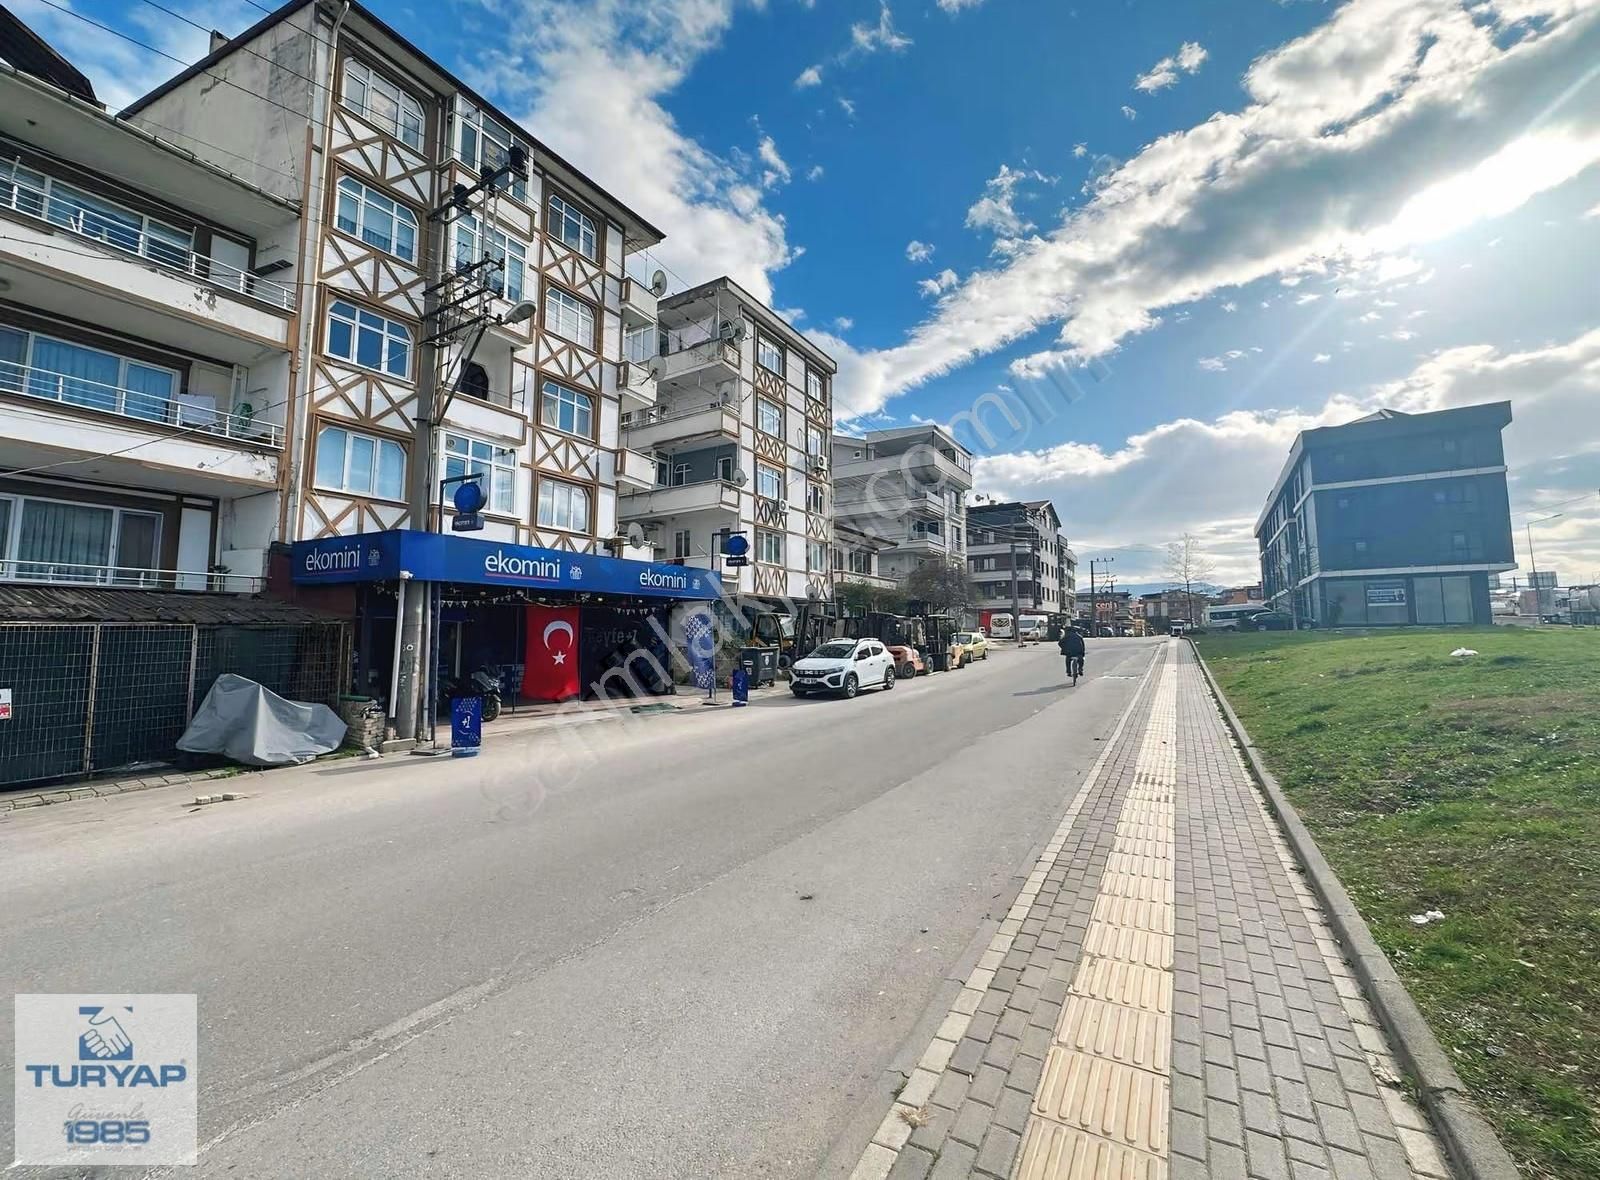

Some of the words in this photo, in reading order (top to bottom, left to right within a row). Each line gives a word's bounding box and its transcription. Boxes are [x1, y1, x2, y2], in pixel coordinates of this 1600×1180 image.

[305, 544, 360, 571] ekomini
[484, 549, 560, 578] ekomini
[639, 567, 687, 589] ekomini
